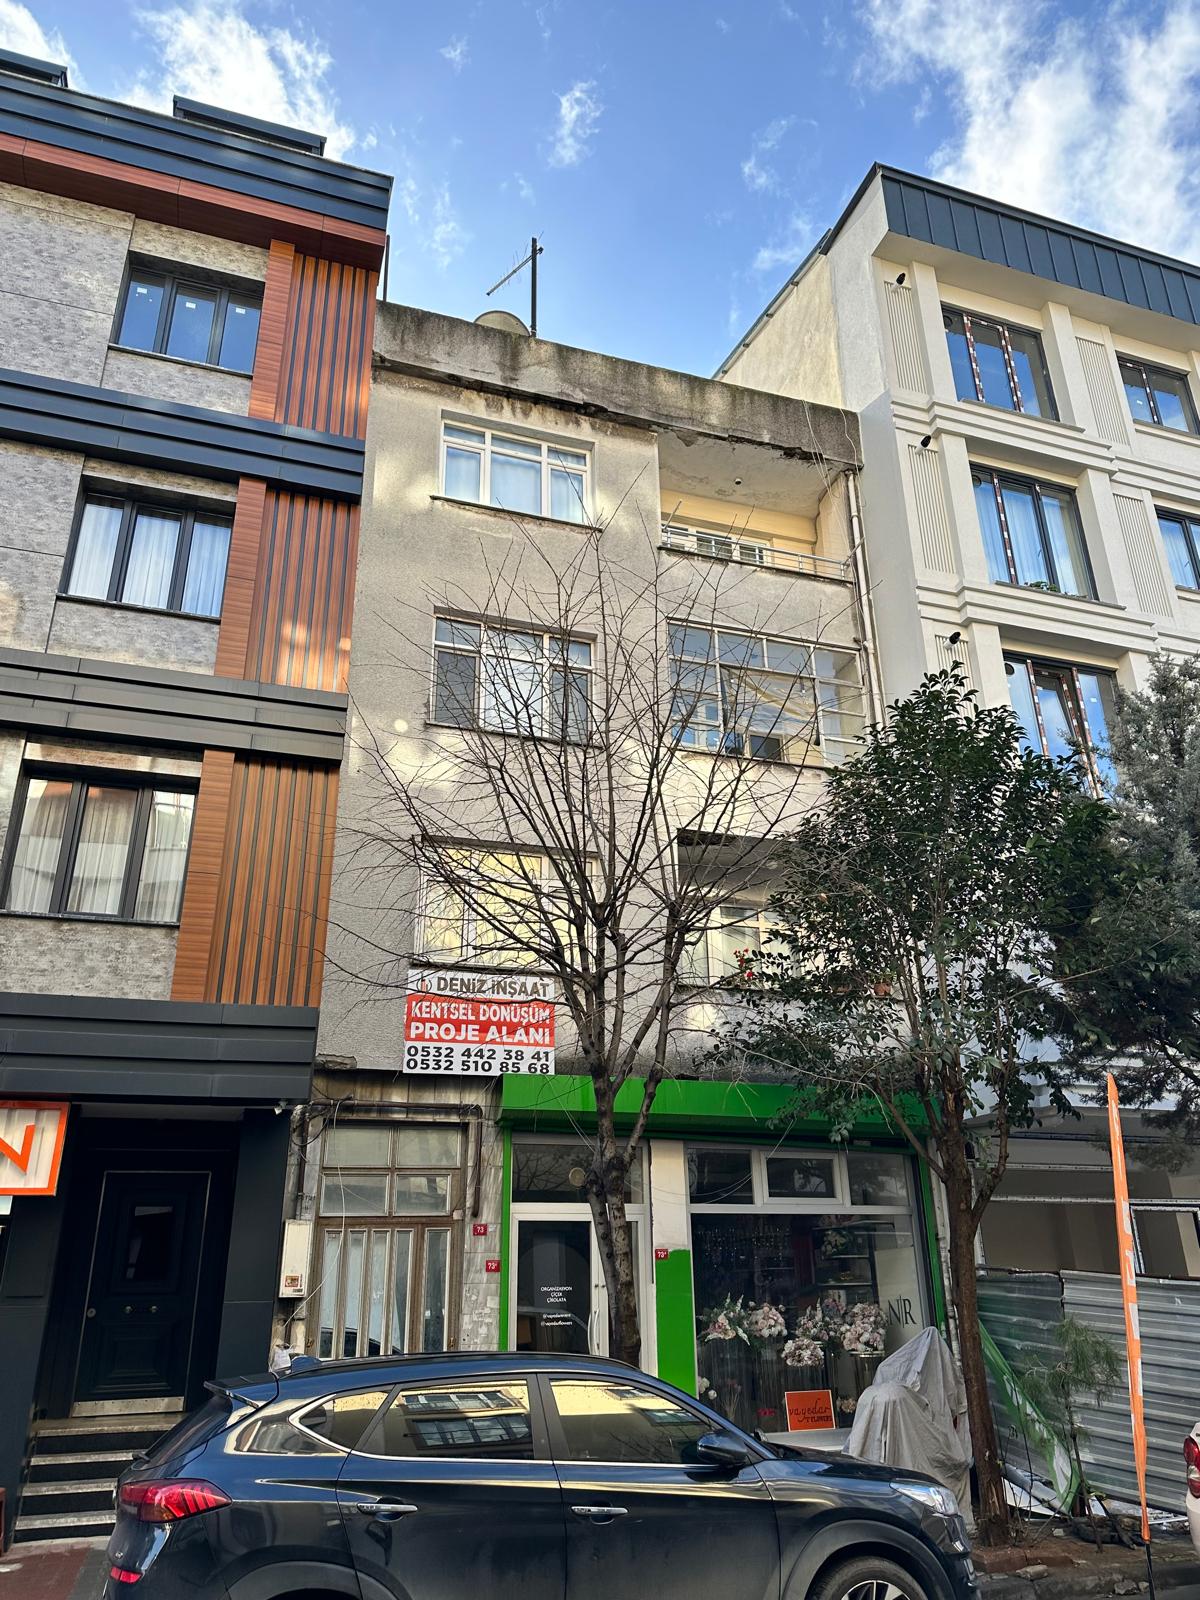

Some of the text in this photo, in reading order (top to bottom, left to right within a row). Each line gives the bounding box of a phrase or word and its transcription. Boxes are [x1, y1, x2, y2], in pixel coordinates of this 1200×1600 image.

[411, 1001, 476, 1020] KENTSEL
[410, 1021, 550, 1045] PROJE ALANI
[407, 1045, 549, 1062] 0532 442 38 41
[406, 1058, 550, 1075] 0532 510 85 68
